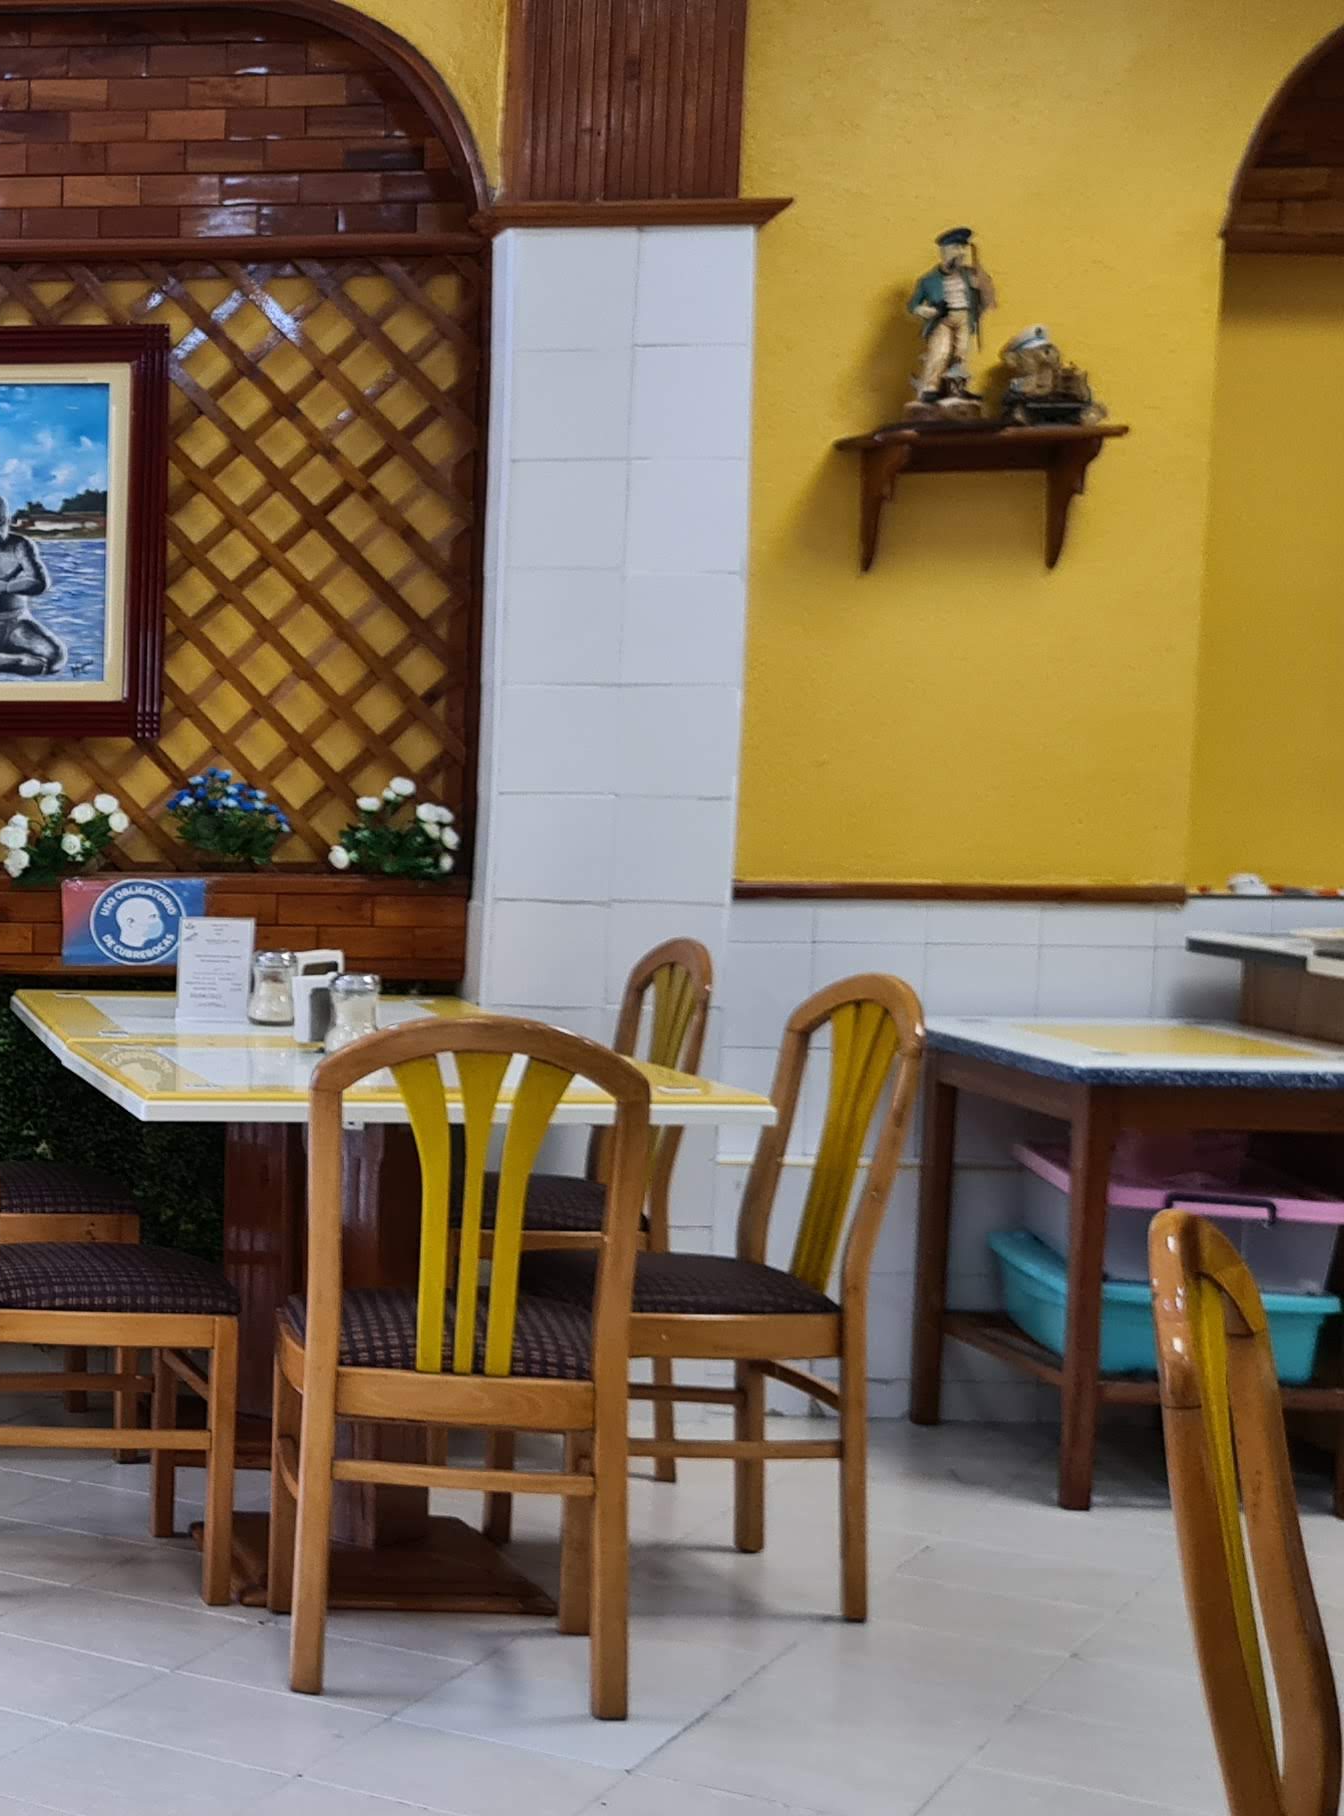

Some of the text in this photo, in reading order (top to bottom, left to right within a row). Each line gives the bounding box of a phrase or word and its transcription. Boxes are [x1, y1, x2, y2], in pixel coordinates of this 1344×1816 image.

[99, 886, 176, 916] USO OBLIGATORIO
[102, 934, 116, 948] DE
[113, 934, 175, 959] CUBREBOCAS
